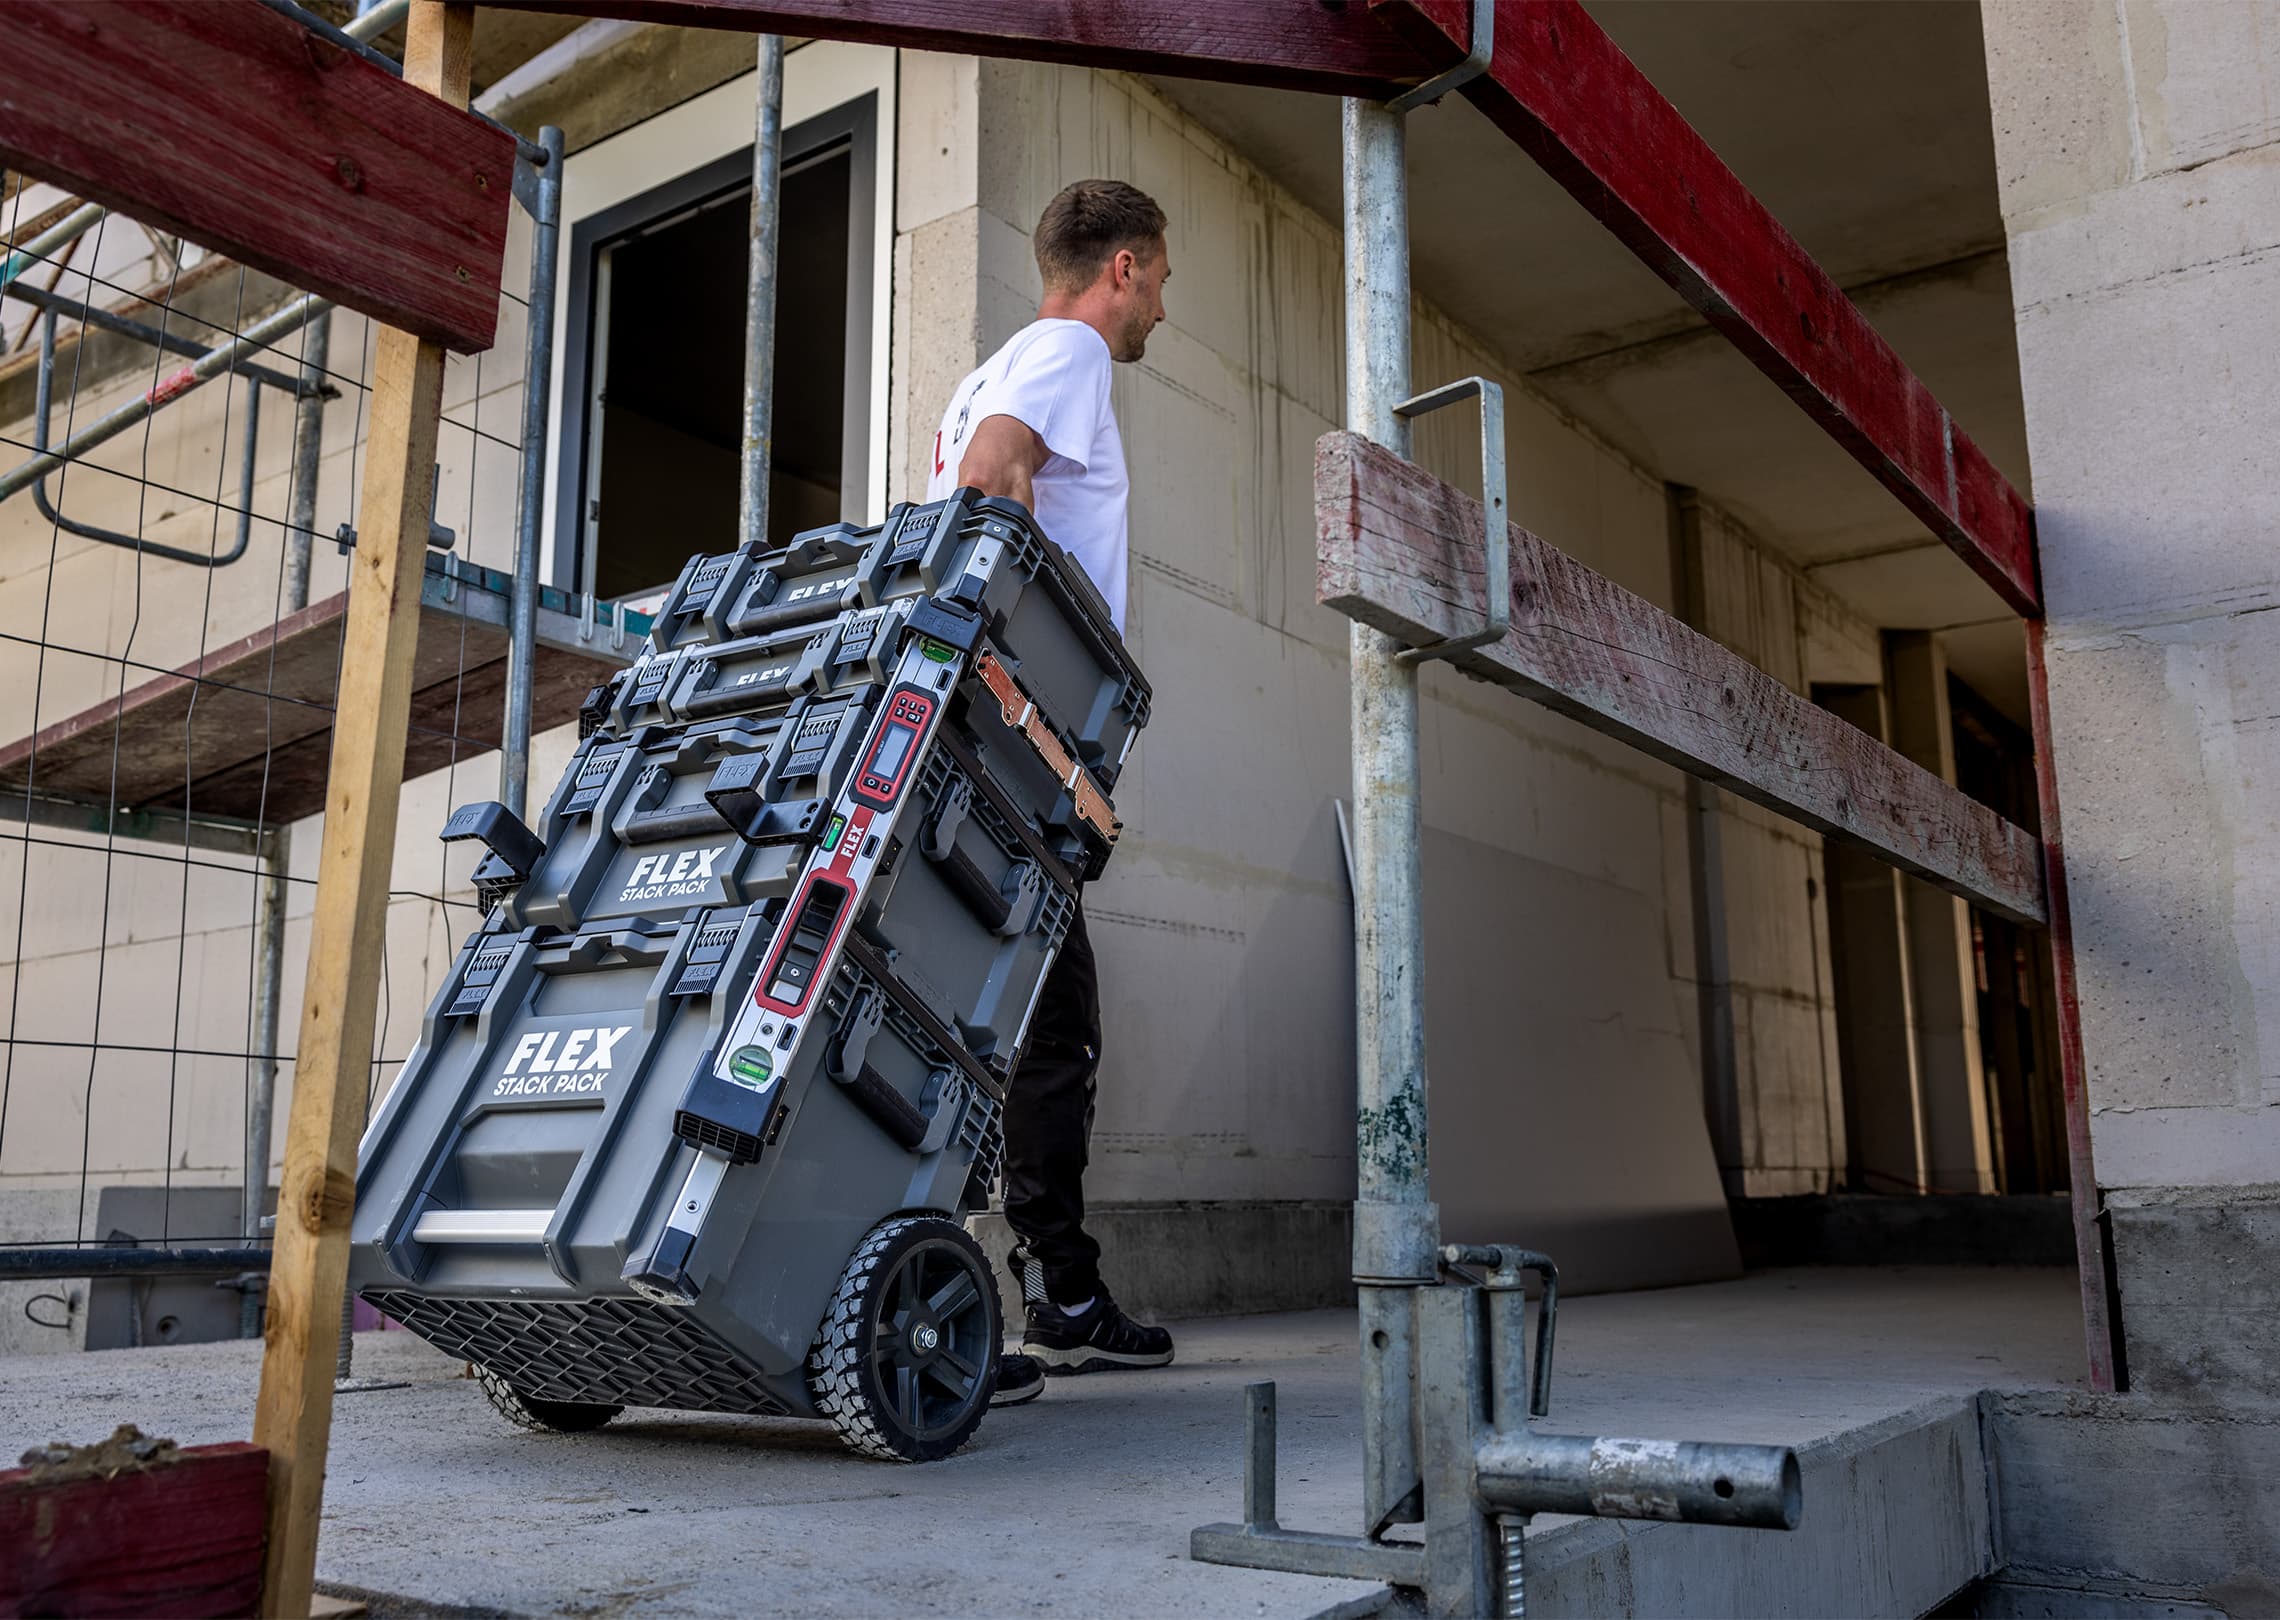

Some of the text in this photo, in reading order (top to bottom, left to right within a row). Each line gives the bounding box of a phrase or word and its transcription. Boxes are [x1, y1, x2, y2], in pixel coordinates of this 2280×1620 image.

[840, 823, 866, 859] FLEX
[626, 846, 727, 888] FLEX
[619, 879, 710, 902] STACK PACK
[503, 1026, 632, 1076] FLEX
[493, 1071, 608, 1096] STACK PACK
